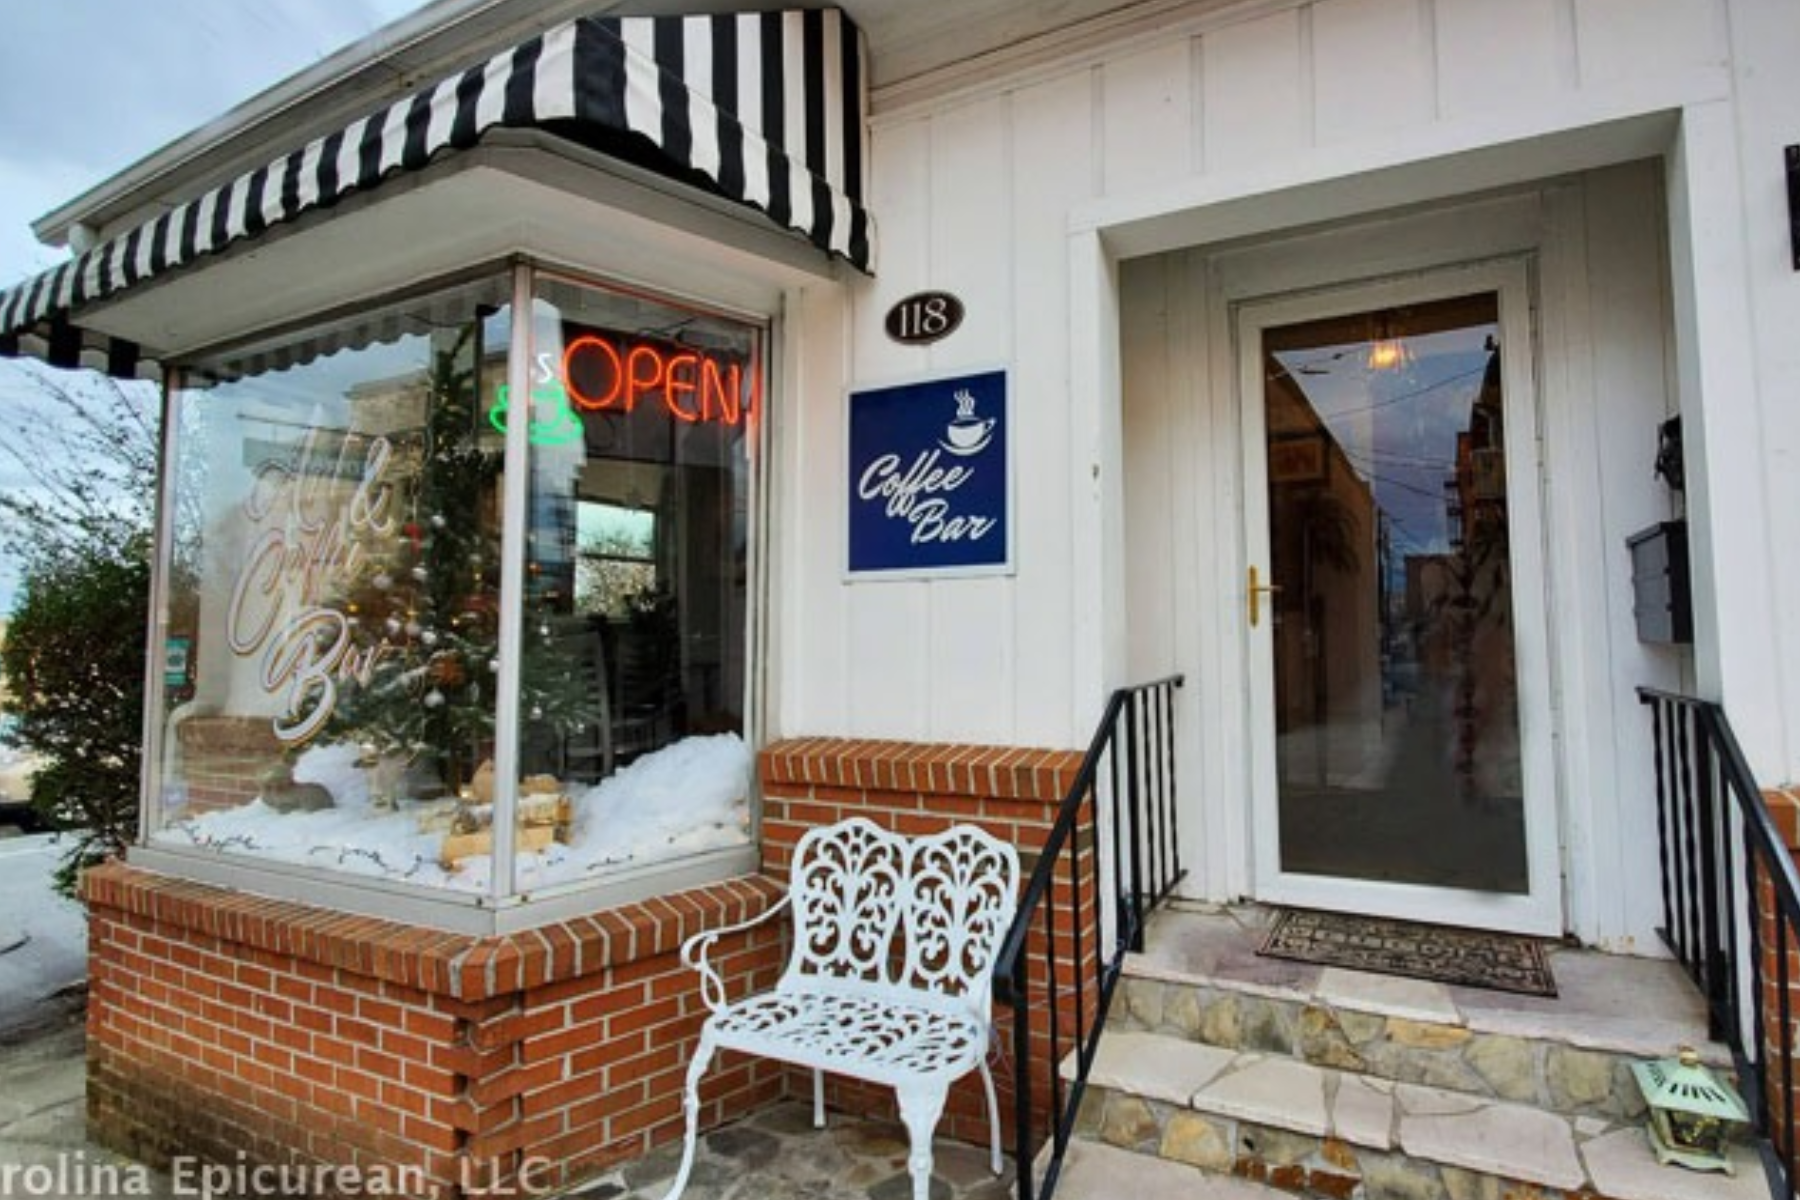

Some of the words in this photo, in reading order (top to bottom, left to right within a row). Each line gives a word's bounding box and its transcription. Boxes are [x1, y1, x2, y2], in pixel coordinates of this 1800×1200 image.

[901, 298, 947, 337] 118
[563, 335, 742, 425] OPEN
[858, 449, 974, 518] Coffee
[908, 498, 997, 544] Bar
